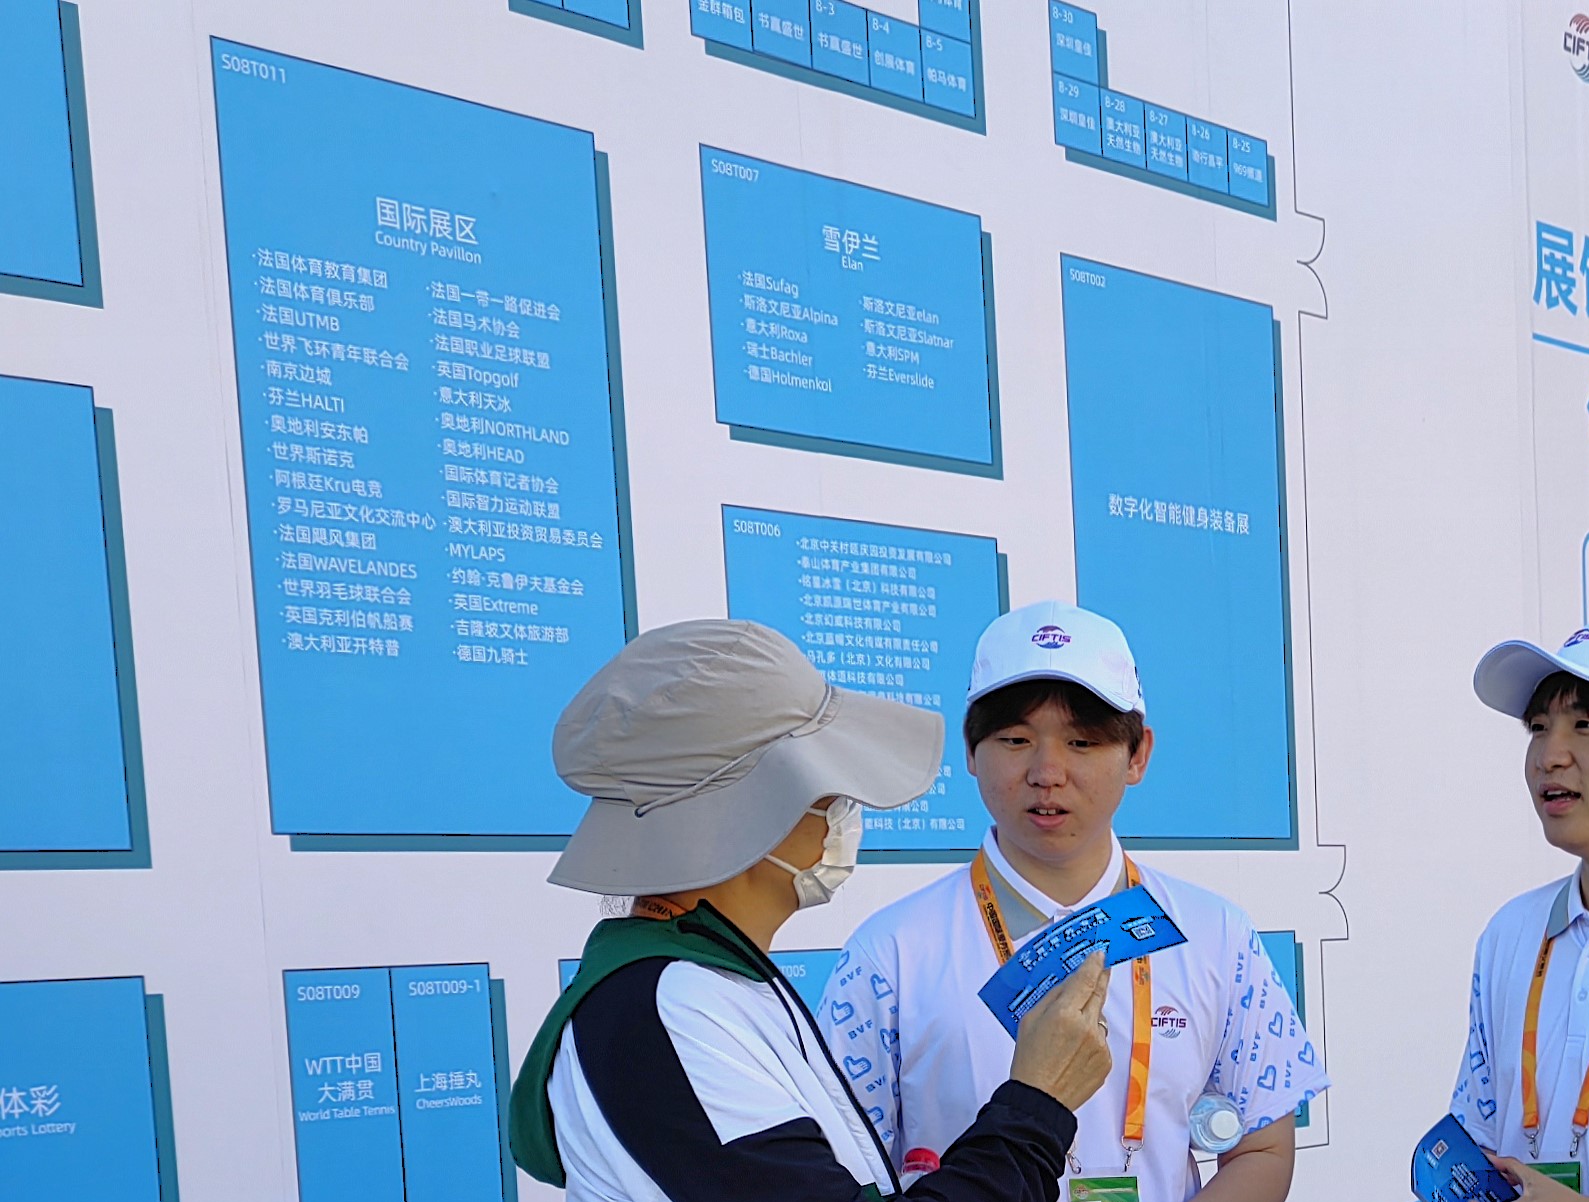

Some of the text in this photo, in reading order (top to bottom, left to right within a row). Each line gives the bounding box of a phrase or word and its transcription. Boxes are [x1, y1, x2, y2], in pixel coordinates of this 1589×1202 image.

[872, 18, 890, 34] 8-4
[1052, 6, 1074, 25] 8-30
[926, 36, 943, 52] 8-5
[221, 53, 288, 84] S08T011
[1058, 81, 1079, 99] 8-29
[1104, 95, 1126, 113] 8-28
[1149, 109, 1169, 127] 8-27
[1191, 123, 1211, 141] 8-26
[1232, 137, 1251, 153] 8-25
[711, 158, 760, 183] S08T007
[375, 196, 480, 246] 国际展区
[375, 230, 428, 259] Country
[822, 224, 881, 261] 雪伊兰
[258, 248, 389, 289] 法国体育教育集团
[841, 255, 864, 272] Elan
[259, 275, 376, 313] 法国体育俱乐部
[430, 280, 562, 322] 法国一带一路促进会
[261, 303, 341, 332] 法国UTMB
[432, 307, 521, 340] 法国马术协会
[744, 293, 839, 326] 斯洛文尼亚Alpina
[862, 295, 940, 325] 斯洛文尼亚elan
[434, 333, 551, 370] 法国职业足球联盟
[265, 359, 333, 387] 南京边城
[747, 364, 833, 393] 德国Holmenkol
[268, 386, 345, 414] 芬兰HALTI
[441, 411, 571, 446] 奥地利NORTHLAND
[271, 441, 356, 470] 世界斯诺克
[442, 437, 526, 465] 奥地利HEAD
[274, 468, 384, 500] 阿根廷Kru电竞
[444, 463, 560, 495] 国际体育记者协会
[276, 496, 437, 531] 罗马尼亚文化交流中心
[446, 490, 561, 520] 国际智力运动联盟
[1108, 492, 1250, 536] 数字化智能健身装备展
[278, 523, 378, 551] 法国飓风集团
[448, 515, 604, 550] 澳大利亚投资贸易委员会
[733, 519, 782, 538] S08T006
[280, 551, 418, 580] 法国WAVELANDES
[449, 542, 507, 563] MYLAPS
[282, 578, 412, 606] 世界羽毛球联合会
[284, 605, 414, 633] 英国克利伯帆船赛
[455, 618, 570, 645] 吉隆坡文体旅游部
[1031, 633, 1072, 643] CIFTIS
[408, 979, 482, 997] S08T009-1
[839, 965, 863, 987] BVF
[297, 984, 361, 1002] S08T009
[847, 1019, 874, 1041] BVF
[1151, 1017, 1188, 1029] CIFTIS
[1250, 1031, 1261, 1062] BVF
[304, 1051, 383, 1077] WTT中国
[1284, 1059, 1292, 1089] BVF
[0, 1085, 62, 1121] 体彩
[317, 1079, 375, 1105] 大满贯
[415, 1094, 483, 1110] CheersWoods
[298, 1104, 396, 1122] World Table Tennis
[31, 1122, 77, 1136] Lottery
